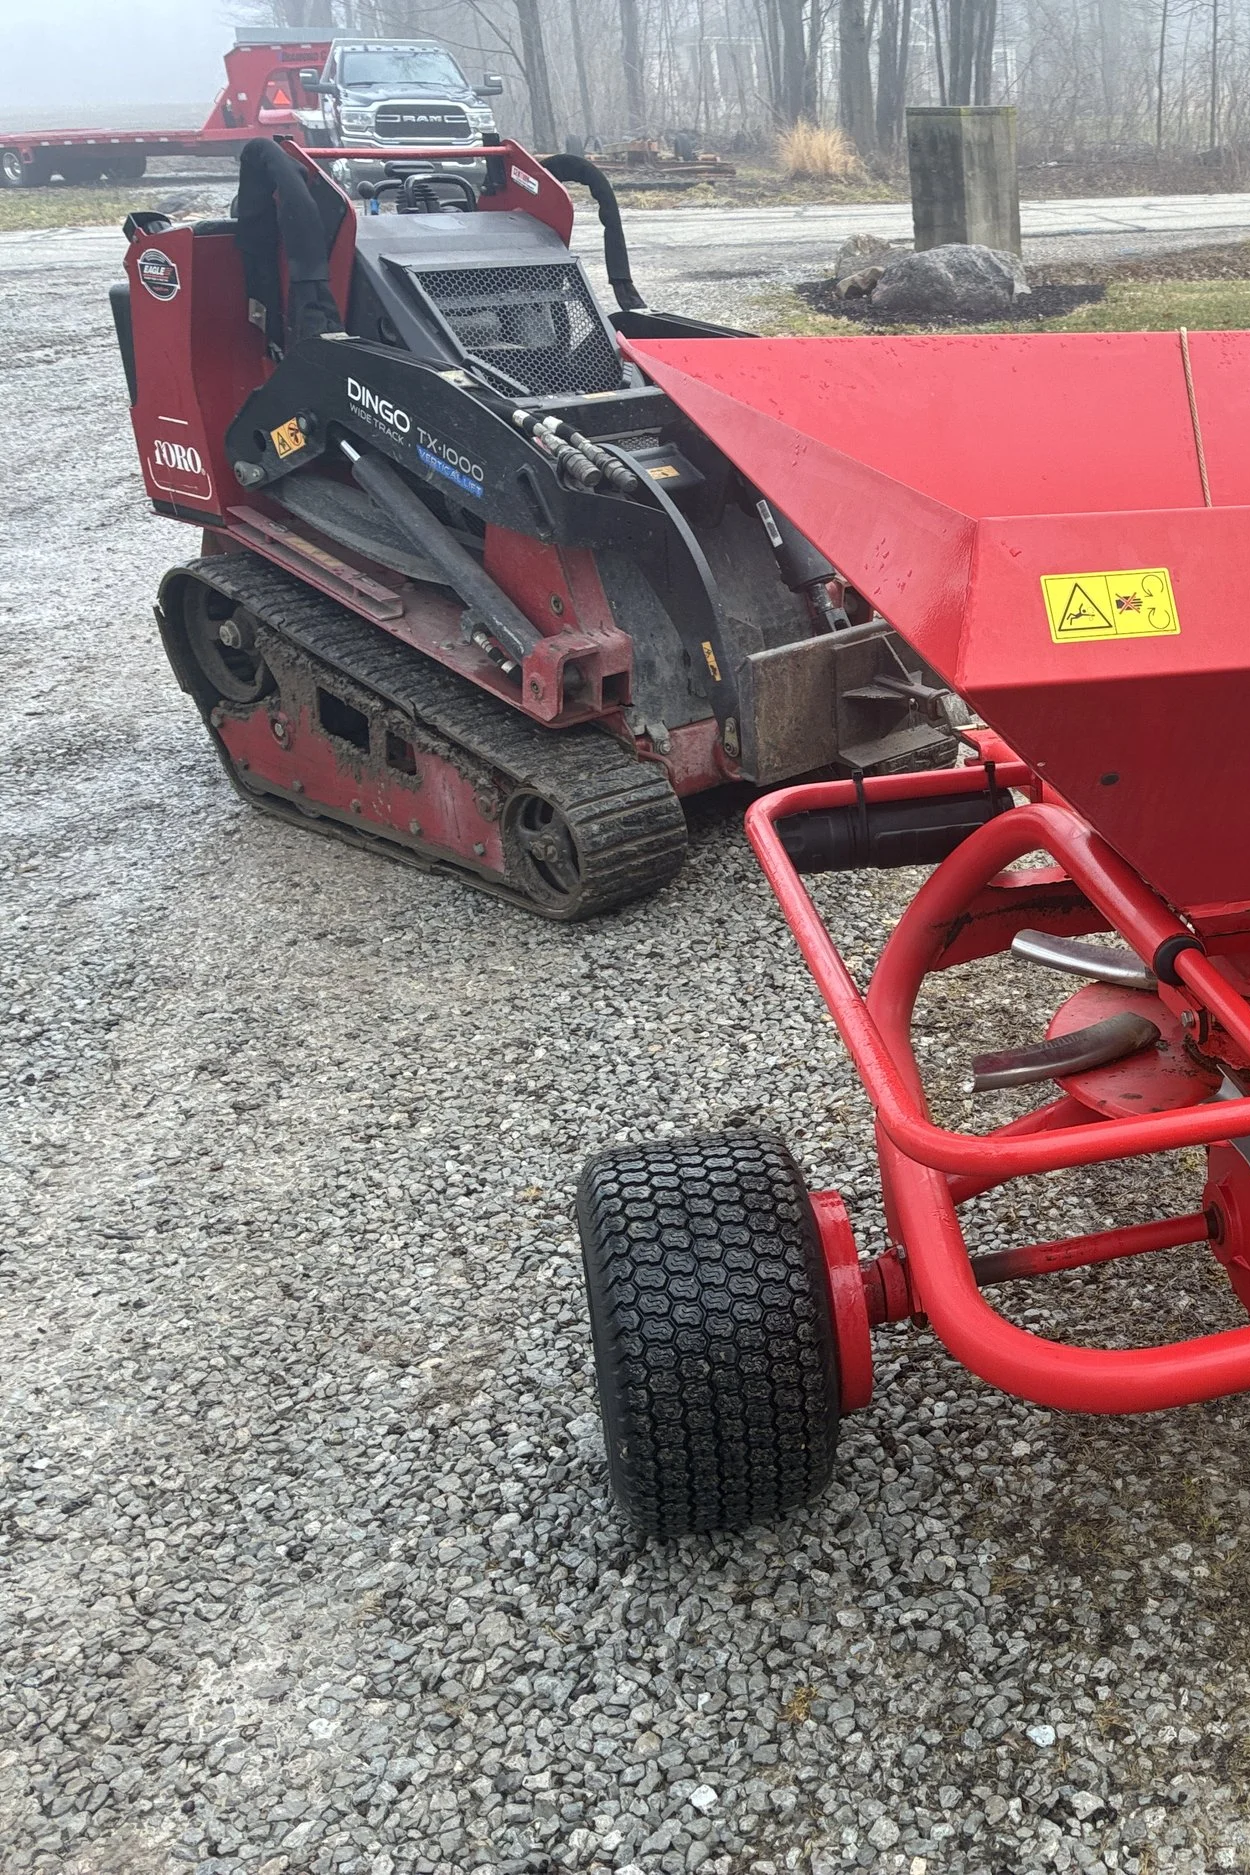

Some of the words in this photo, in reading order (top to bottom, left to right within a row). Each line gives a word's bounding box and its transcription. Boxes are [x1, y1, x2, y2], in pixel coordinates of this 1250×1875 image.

[143, 265, 165, 276] EAGLE
[347, 377, 410, 433] DINGO
[349, 402, 372, 424] WIDE
[372, 417, 404, 446] TRACK
[154, 439, 202, 475] TORO
[418, 447, 463, 481] VERTICAL
[464, 477, 483, 497] LIFT
